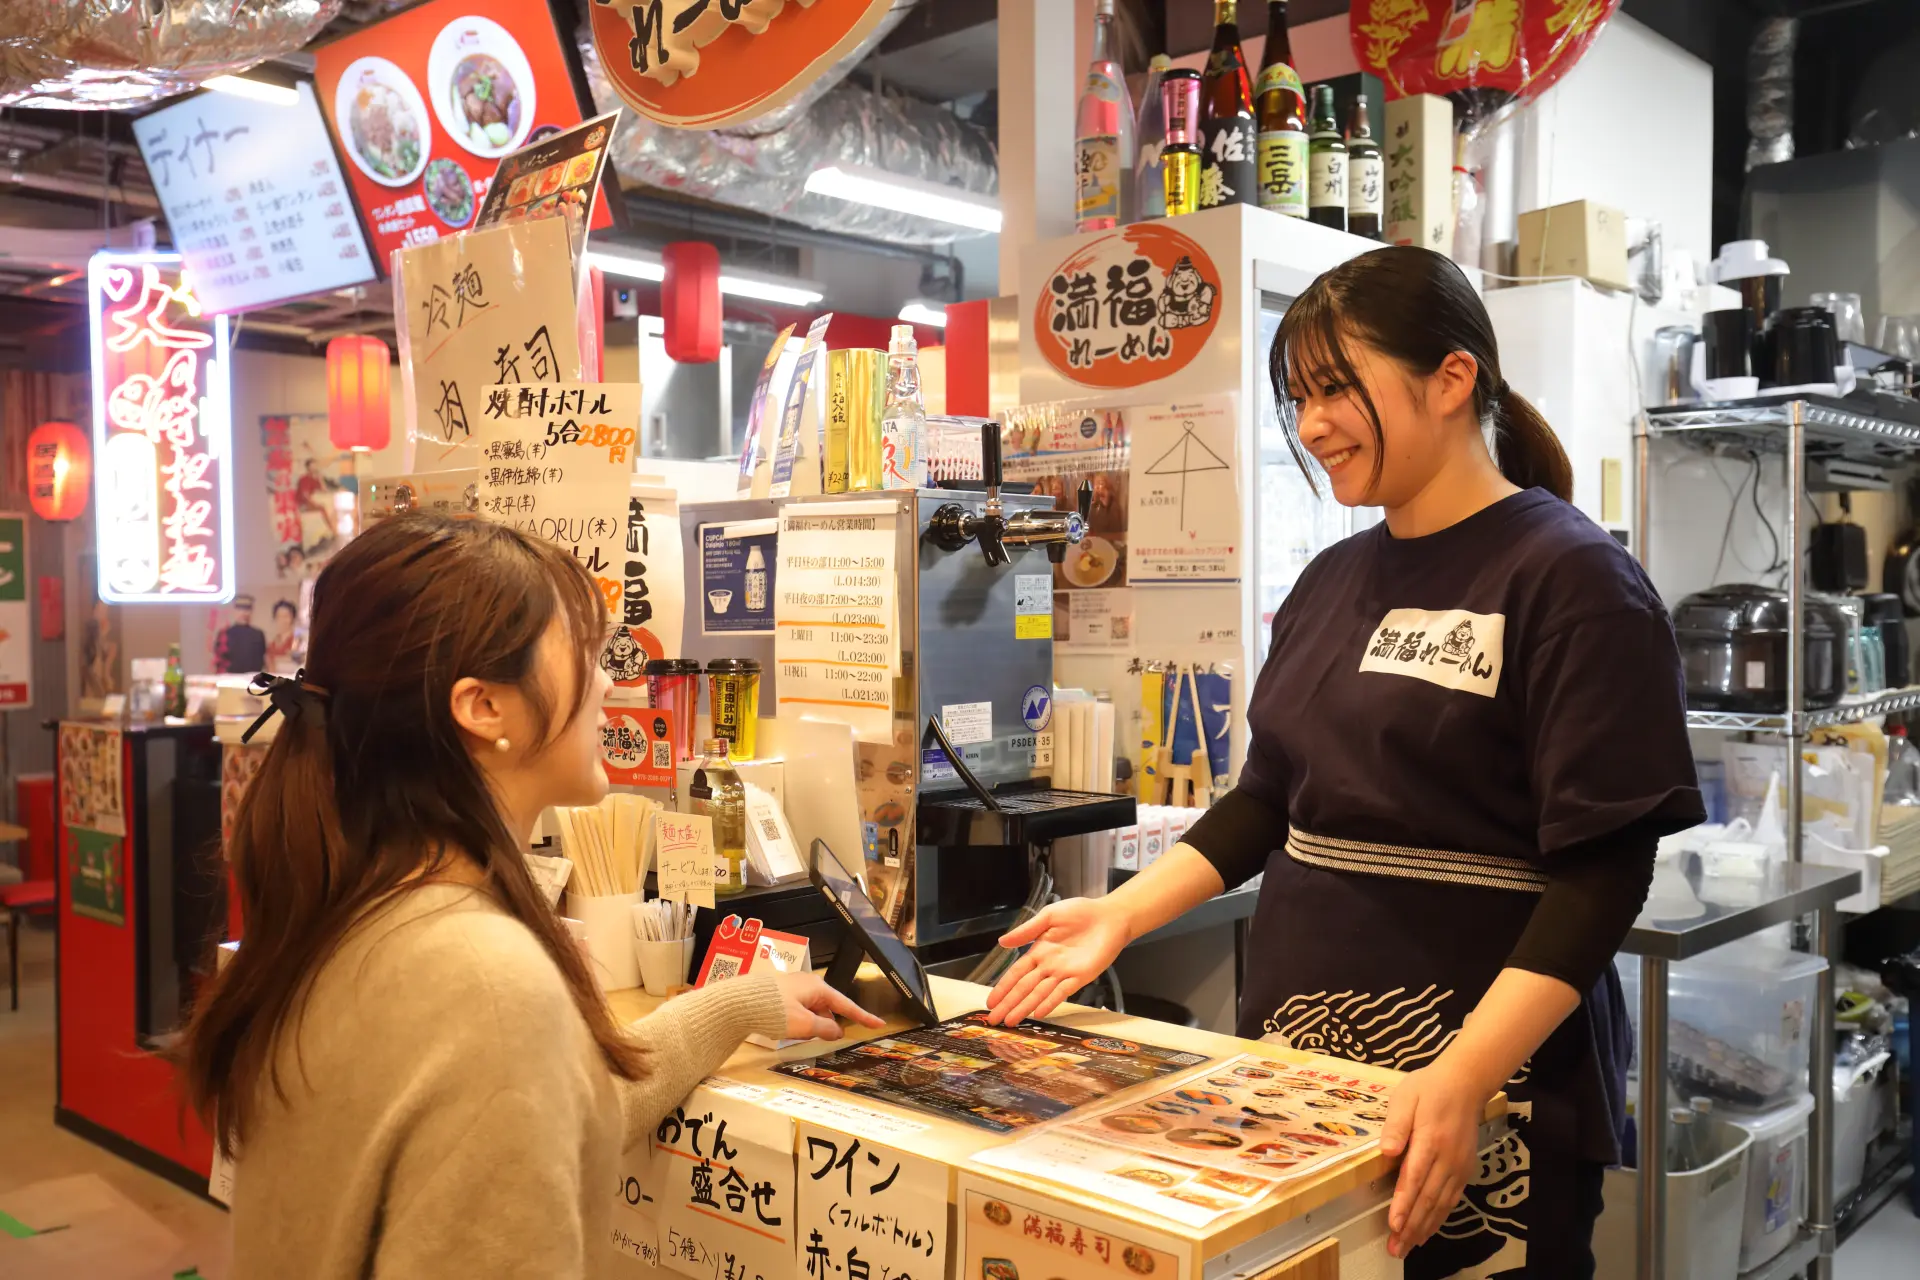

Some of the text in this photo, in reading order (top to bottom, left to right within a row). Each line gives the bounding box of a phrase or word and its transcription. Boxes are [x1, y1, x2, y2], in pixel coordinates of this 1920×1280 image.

[629, 0, 750, 73] れー
[147, 117, 250, 187] ディナー
[1264, 145, 1296, 195] 三岳
[1325, 157, 1343, 198] 白州
[1051, 259, 1157, 333] 満福
[1067, 326, 1170, 366] れーめん
[484, 387, 612, 420] 焼酎ボトル
[576, 424, 636, 447] 2800
[608, 446, 626, 464] 円
[790, 629, 813, 642] 土曜日
[783, 665, 808, 678] 日祝日
[723, 681, 736, 724] 自由飲み
[602, 727, 632, 749] 満福
[1011, 736, 1051, 748] PSDEX-35
[771, 948, 798, 964] PayPay
[656, 1106, 738, 1161] おでん
[806, 1136, 900, 1198] ワイン
[690, 1157, 782, 1227] 盛合せ
[828, 1201, 934, 1258] (フルボトル)
[1022, 1214, 1112, 1265] 満福寿司
